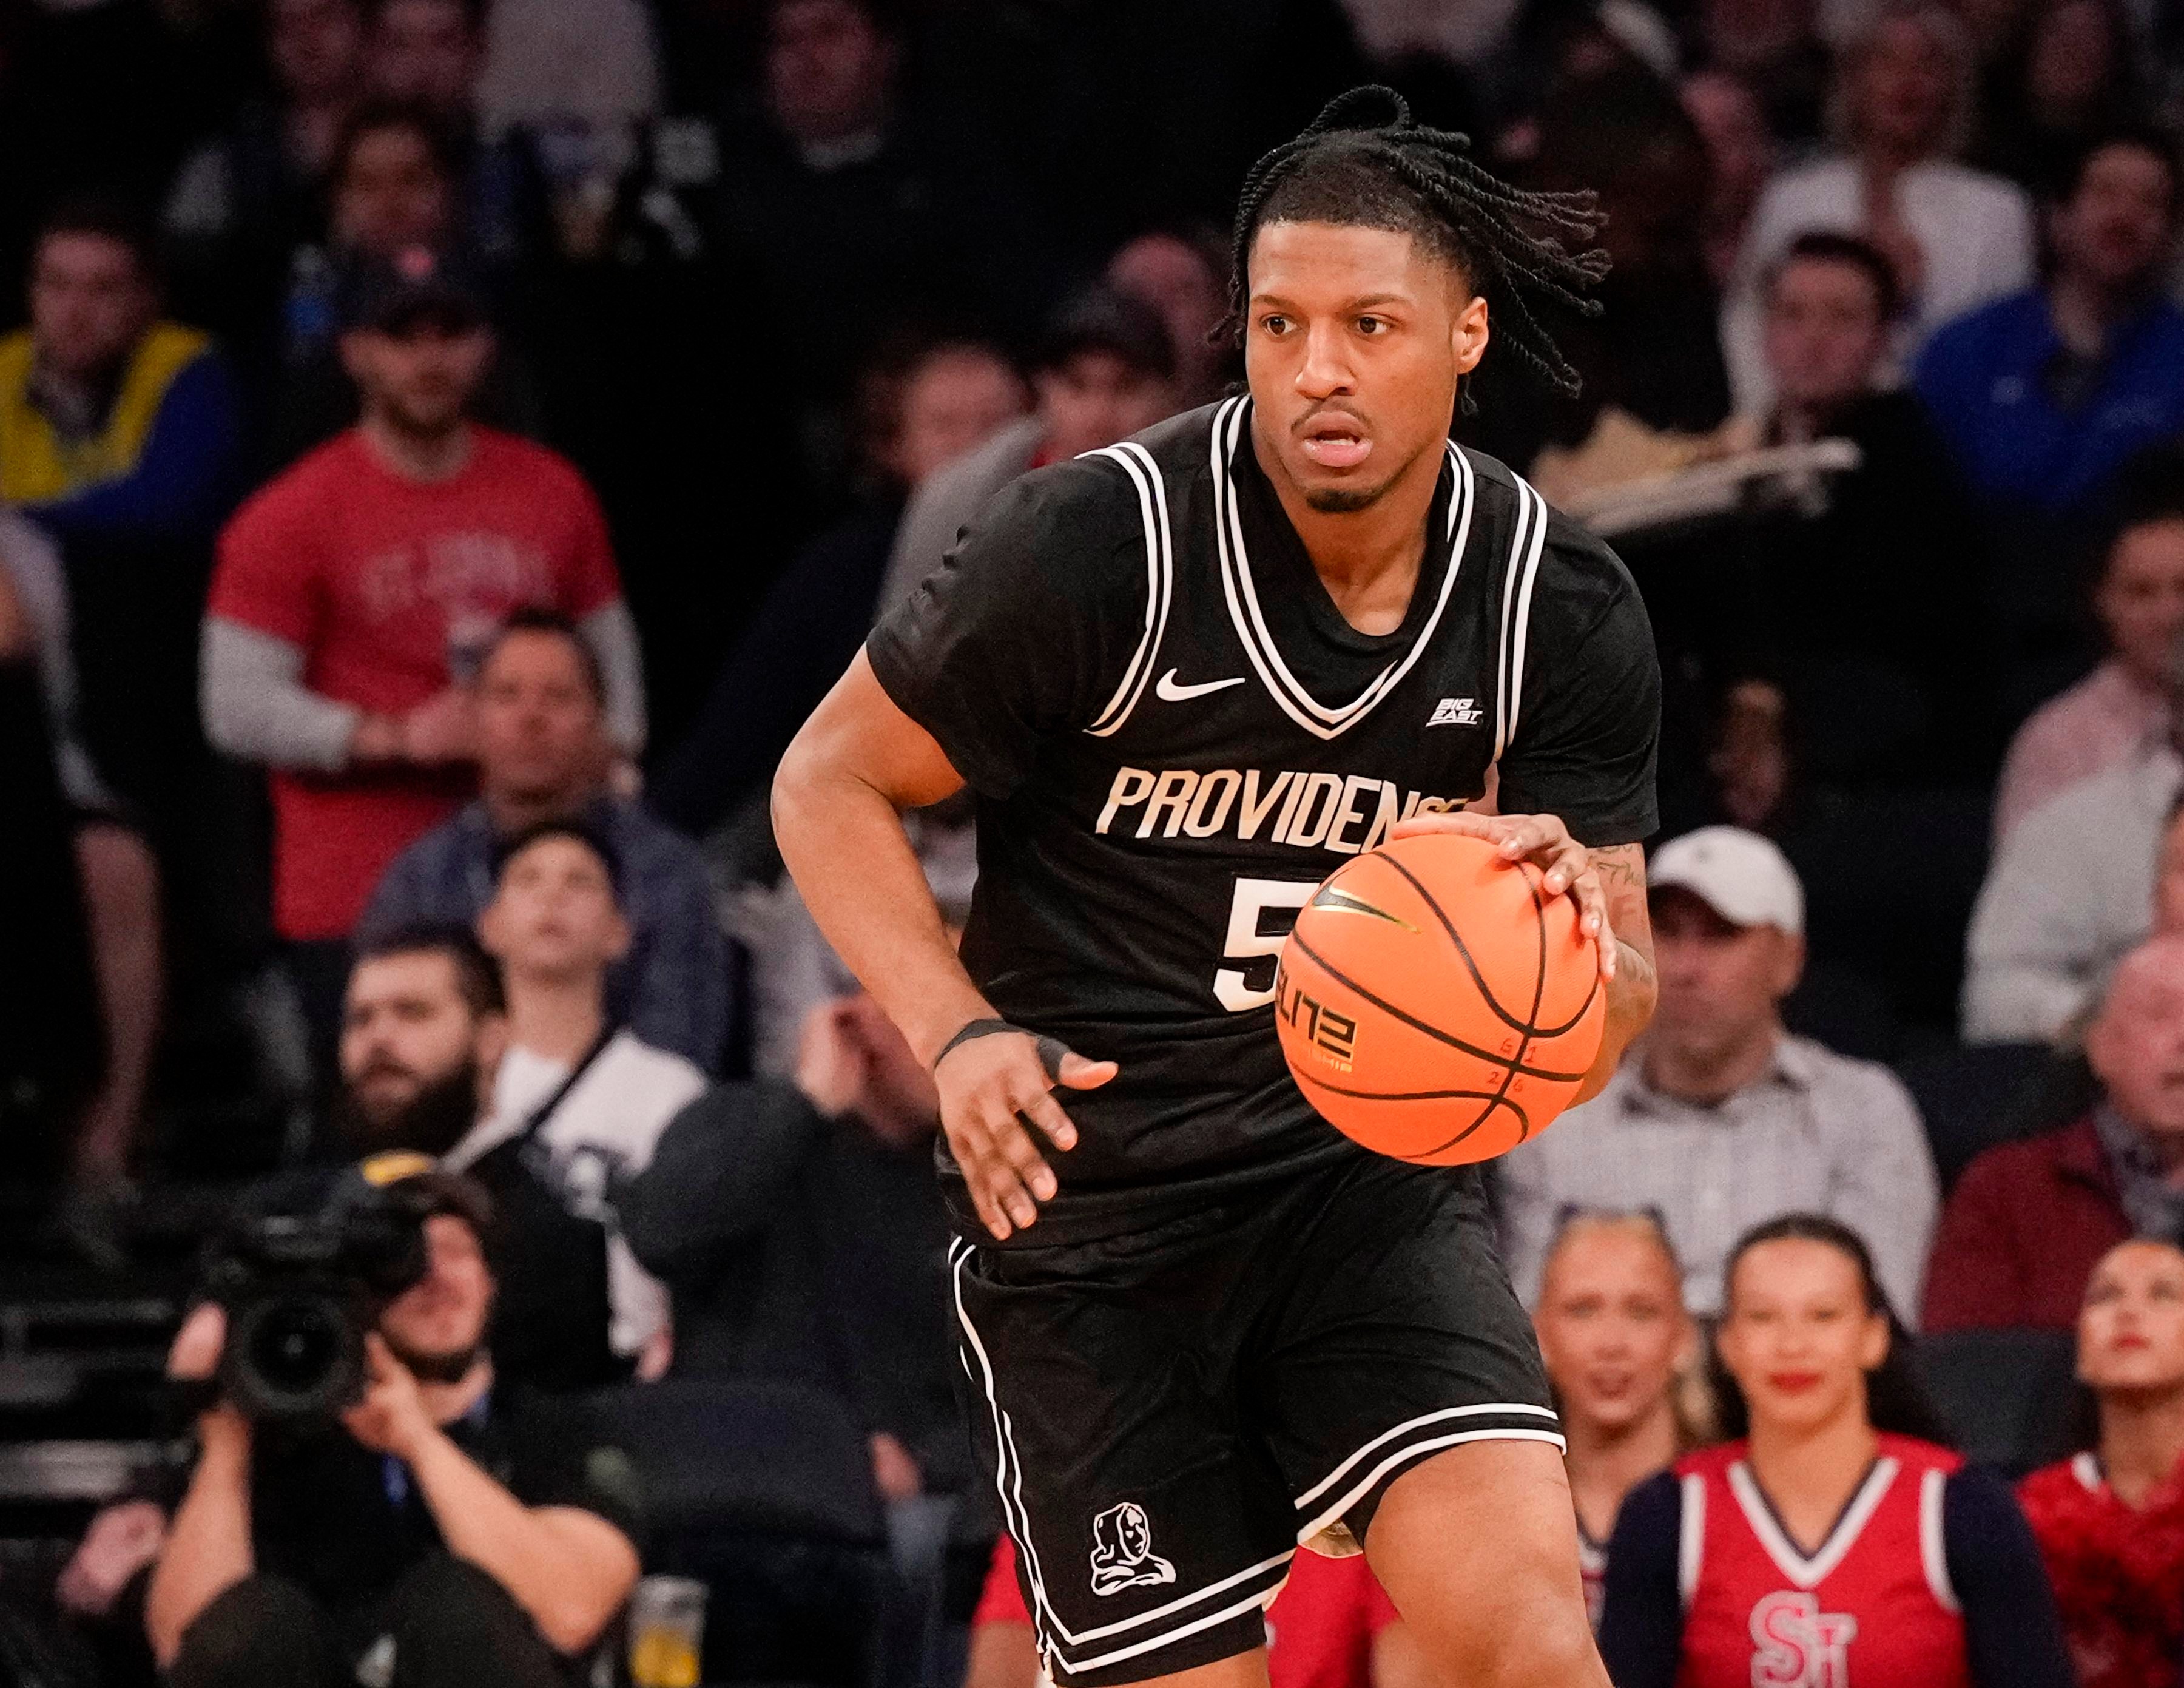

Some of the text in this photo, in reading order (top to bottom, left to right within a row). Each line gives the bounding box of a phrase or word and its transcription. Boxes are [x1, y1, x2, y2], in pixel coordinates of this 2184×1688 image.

[1435, 698, 1474, 711] BIG
[1429, 709, 1483, 721] EAST
[1213, 877, 1321, 1012] 5
